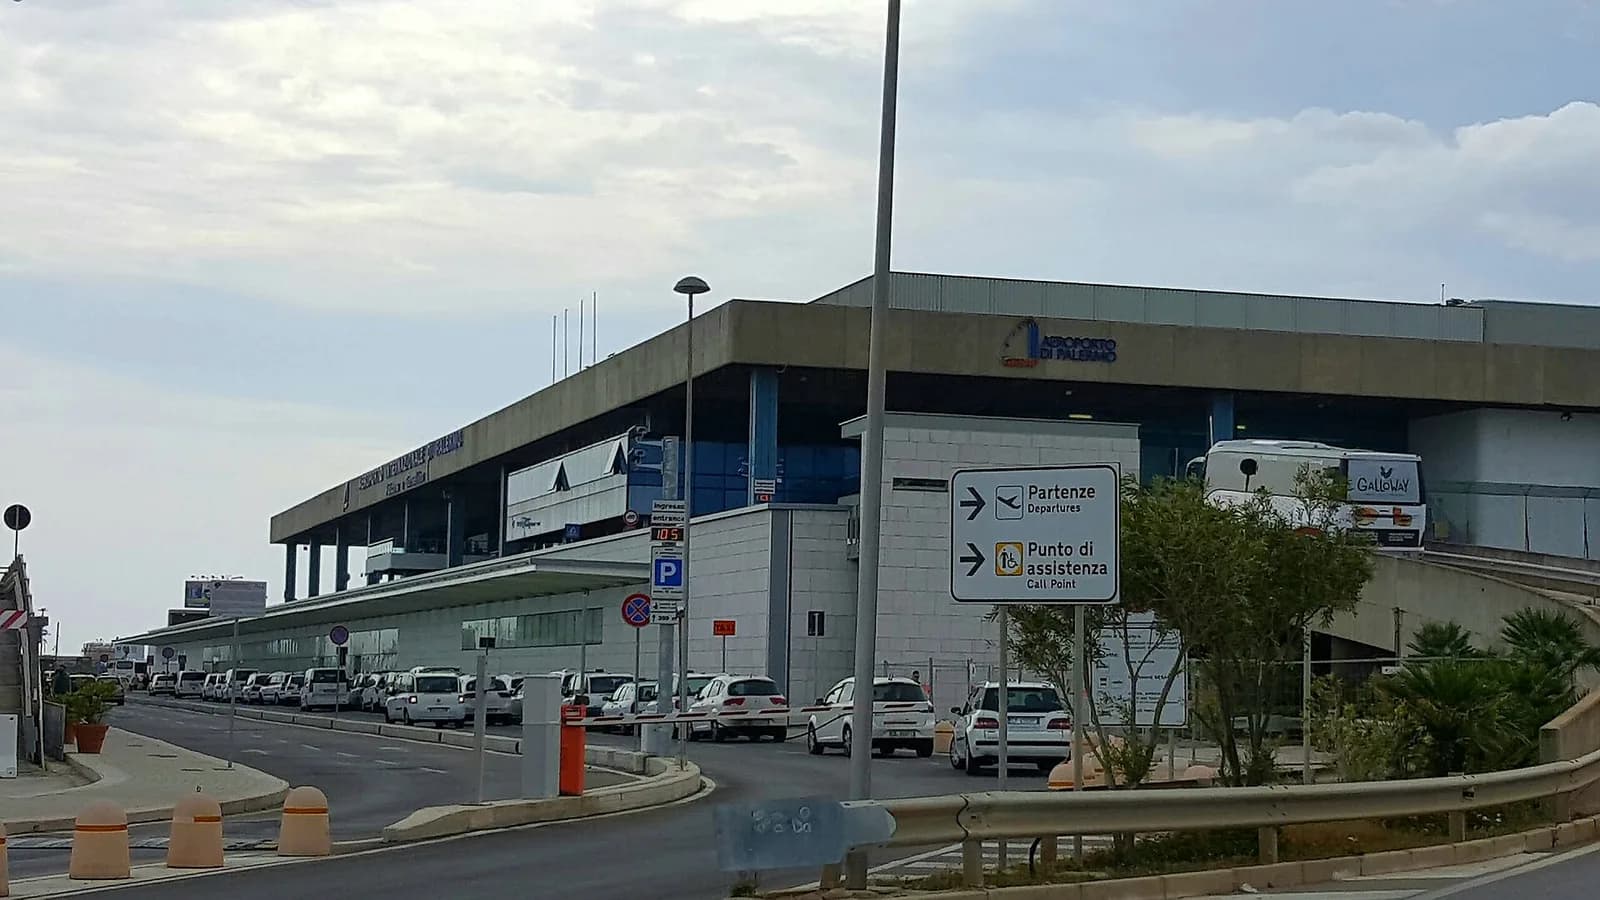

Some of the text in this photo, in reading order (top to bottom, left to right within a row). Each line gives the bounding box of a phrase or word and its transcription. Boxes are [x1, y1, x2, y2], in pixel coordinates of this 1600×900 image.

[1028, 484, 1096, 500] Partenze
[1357, 477, 1409, 493] GALLOWAY
[1027, 503, 1081, 514] Departures
[1028, 541, 1094, 557] Punto di
[660, 562, 677, 583] P
[1027, 560, 1108, 576] assistenza
[1027, 579, 1076, 589] Call Point
